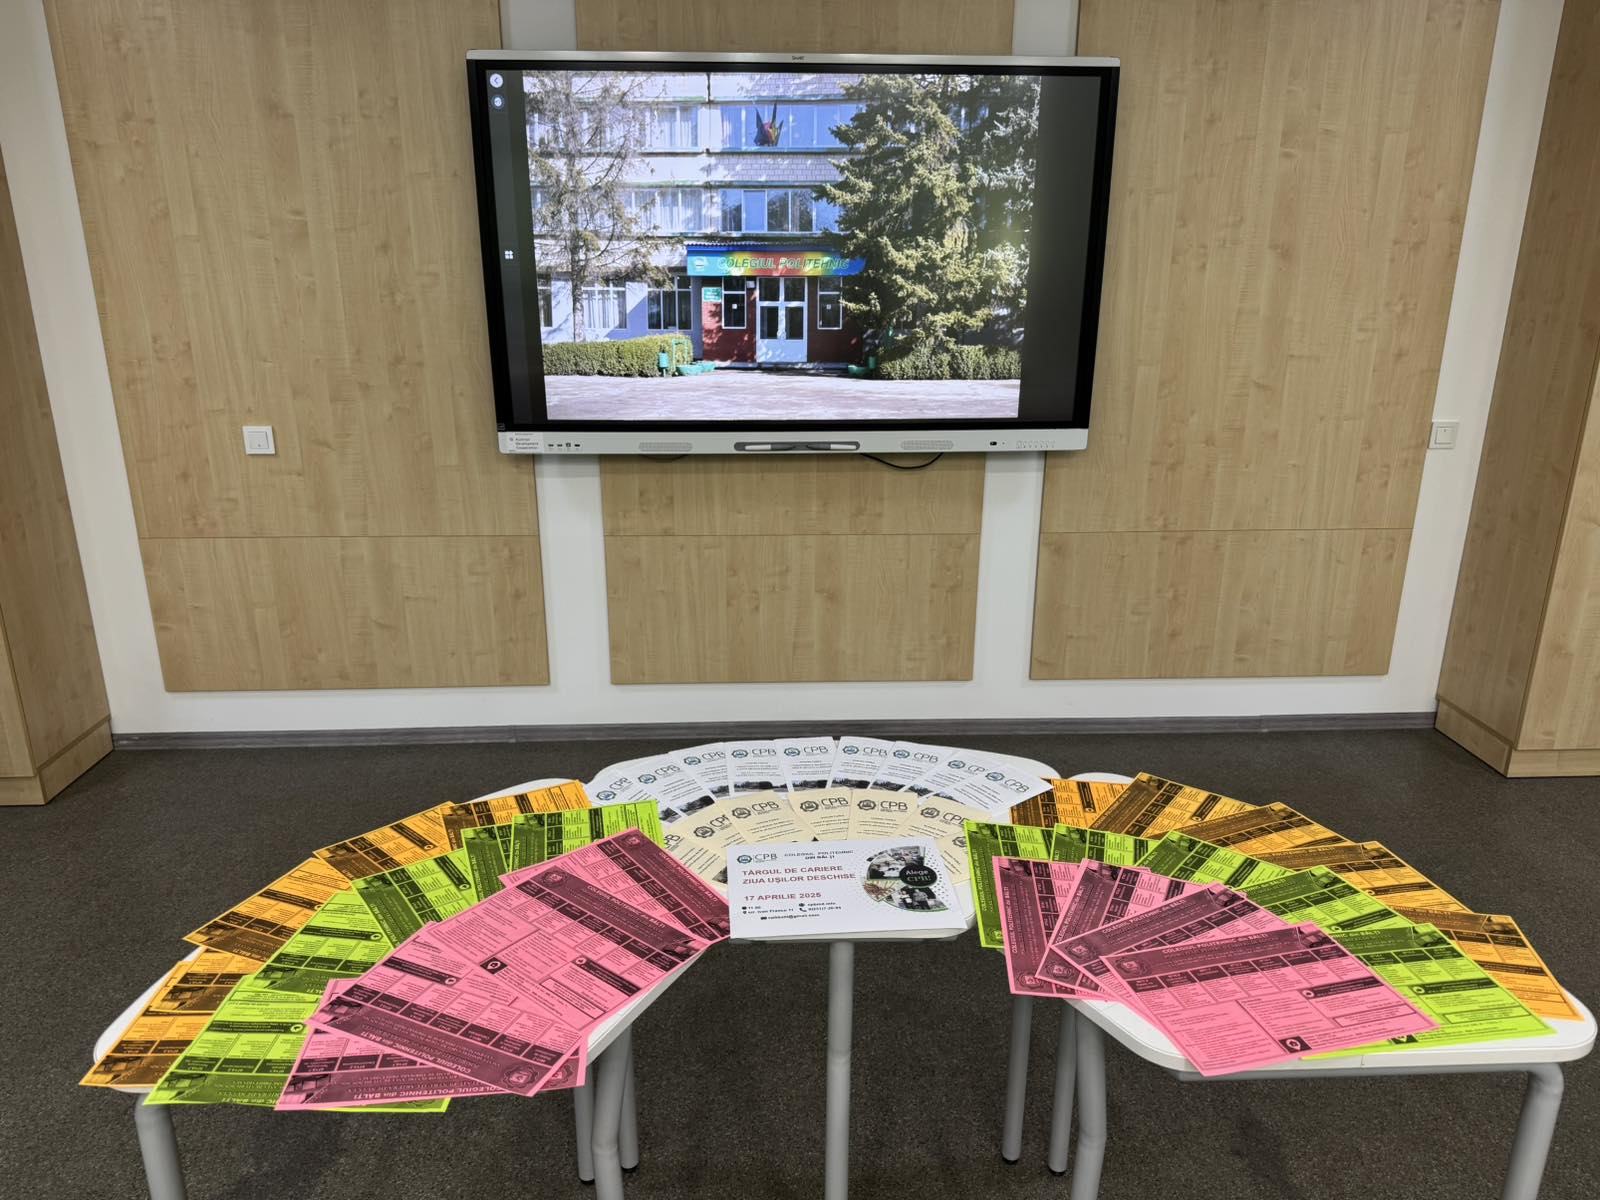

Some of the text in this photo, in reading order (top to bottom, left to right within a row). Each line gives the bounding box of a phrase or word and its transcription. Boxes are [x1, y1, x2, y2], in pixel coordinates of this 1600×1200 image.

[717, 257, 849, 270] COLEGIUL POLITEHNIC
[752, 748, 776, 756] CPB
[804, 745, 828, 754] CPB
[863, 746, 888, 756] CPB
[913, 752, 938, 763] CPB
[655, 764, 680, 776] CPB
[967, 764, 985, 773] CP
[1004, 778, 1029, 793] CPB
[751, 801, 779, 812] CPB
[820, 796, 849, 807] CPB
[880, 800, 908, 811] CPB
[754, 852, 778, 860] CPB
[800, 865, 843, 873] CARIERE
[905, 869, 929, 877] Alege
[742, 877, 766, 885] ZIUA
[807, 873, 856, 881] DESCHISE
[757, 893, 797, 901] APRILIE
[392, 1041, 435, 1061] POLITEHNIC
[435, 1057, 471, 1074] COLEGIUL
[399, 1086, 454, 1098] POLITEHNIC
